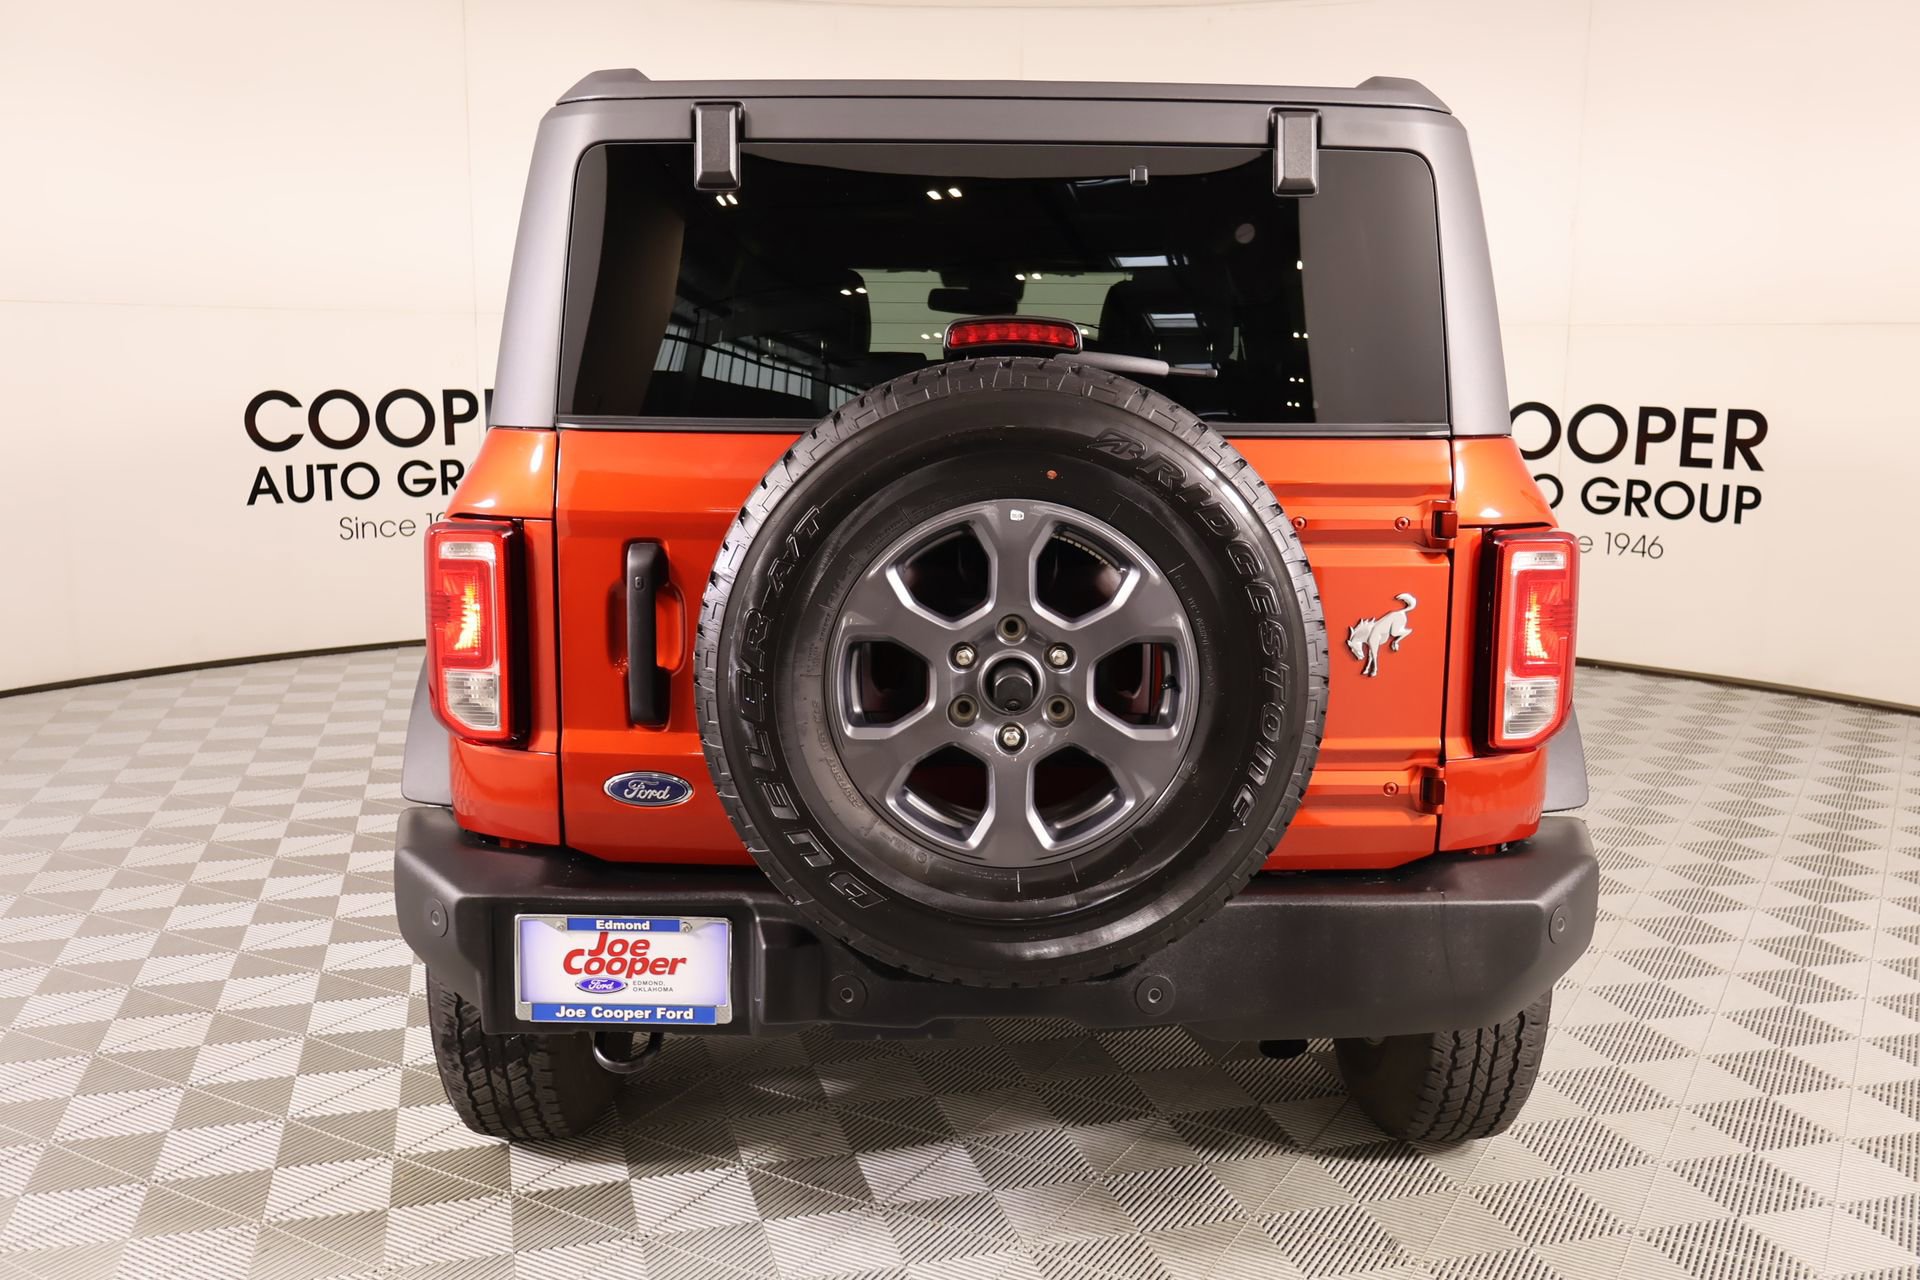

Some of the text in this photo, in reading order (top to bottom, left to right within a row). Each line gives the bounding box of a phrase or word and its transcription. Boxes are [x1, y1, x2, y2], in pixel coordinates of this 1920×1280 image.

[244, 388, 495, 453] COOP
[1510, 401, 1769, 472] OOPER
[246, 461, 381, 506] AUTO
[1580, 476, 1763, 525] GROUP
[339, 516, 417, 541] Since
[1604, 531, 1665, 560] 1946
[1086, 427, 1291, 829] BRIDGESTONE
[736, 607, 889, 909] DUELER
[623, 779, 672, 799] Ford
[595, 919, 651, 931] Edmond
[588, 931, 651, 958] Joe
[562, 948, 688, 979] Cooper
[588, 978, 615, 991] Ford
[555, 1005, 694, 1021] Joe Cooper Ford
